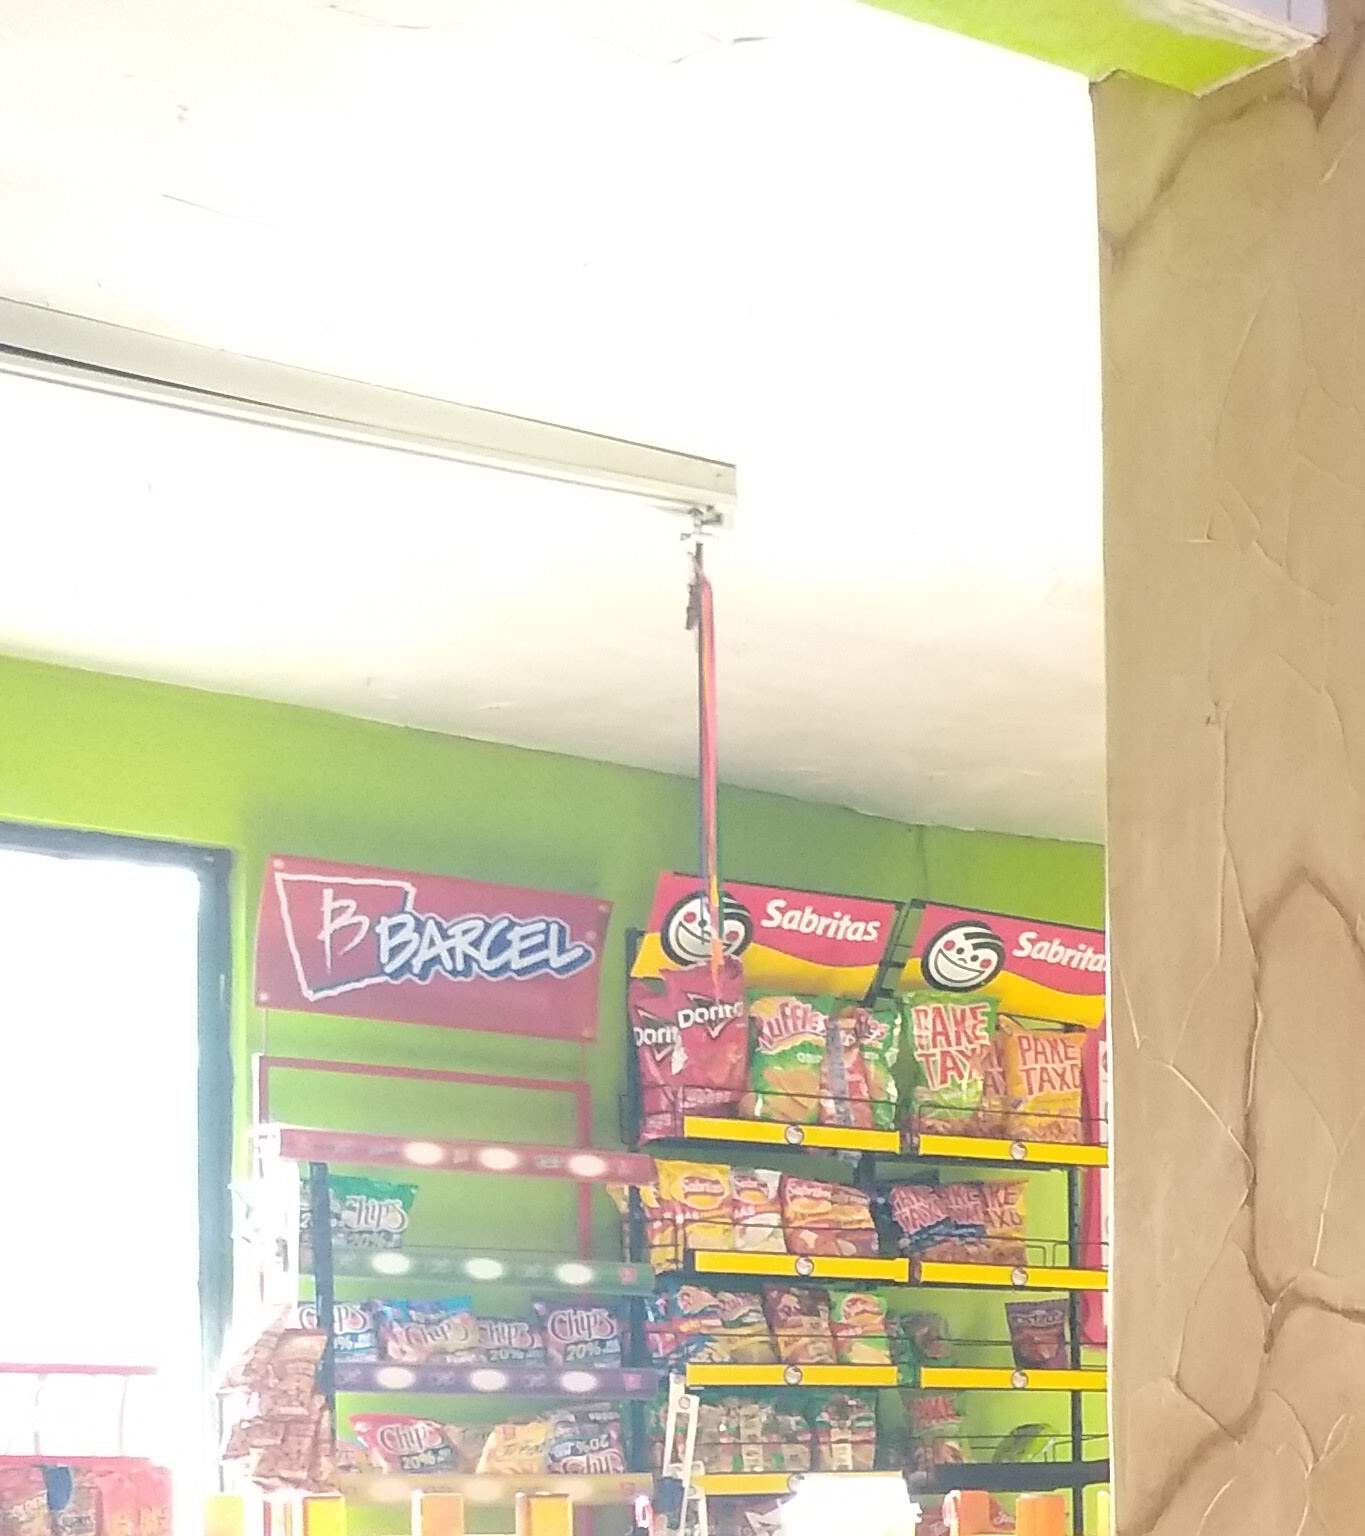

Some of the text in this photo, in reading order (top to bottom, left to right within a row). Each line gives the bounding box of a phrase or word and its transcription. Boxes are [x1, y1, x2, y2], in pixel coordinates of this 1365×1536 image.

[760, 899, 882, 942] Sabritas
[374, 913, 592, 981] BARCEL
[1012, 930, 1108, 973] Sabrita
[1018, 1033, 1081, 1067] PAKE
